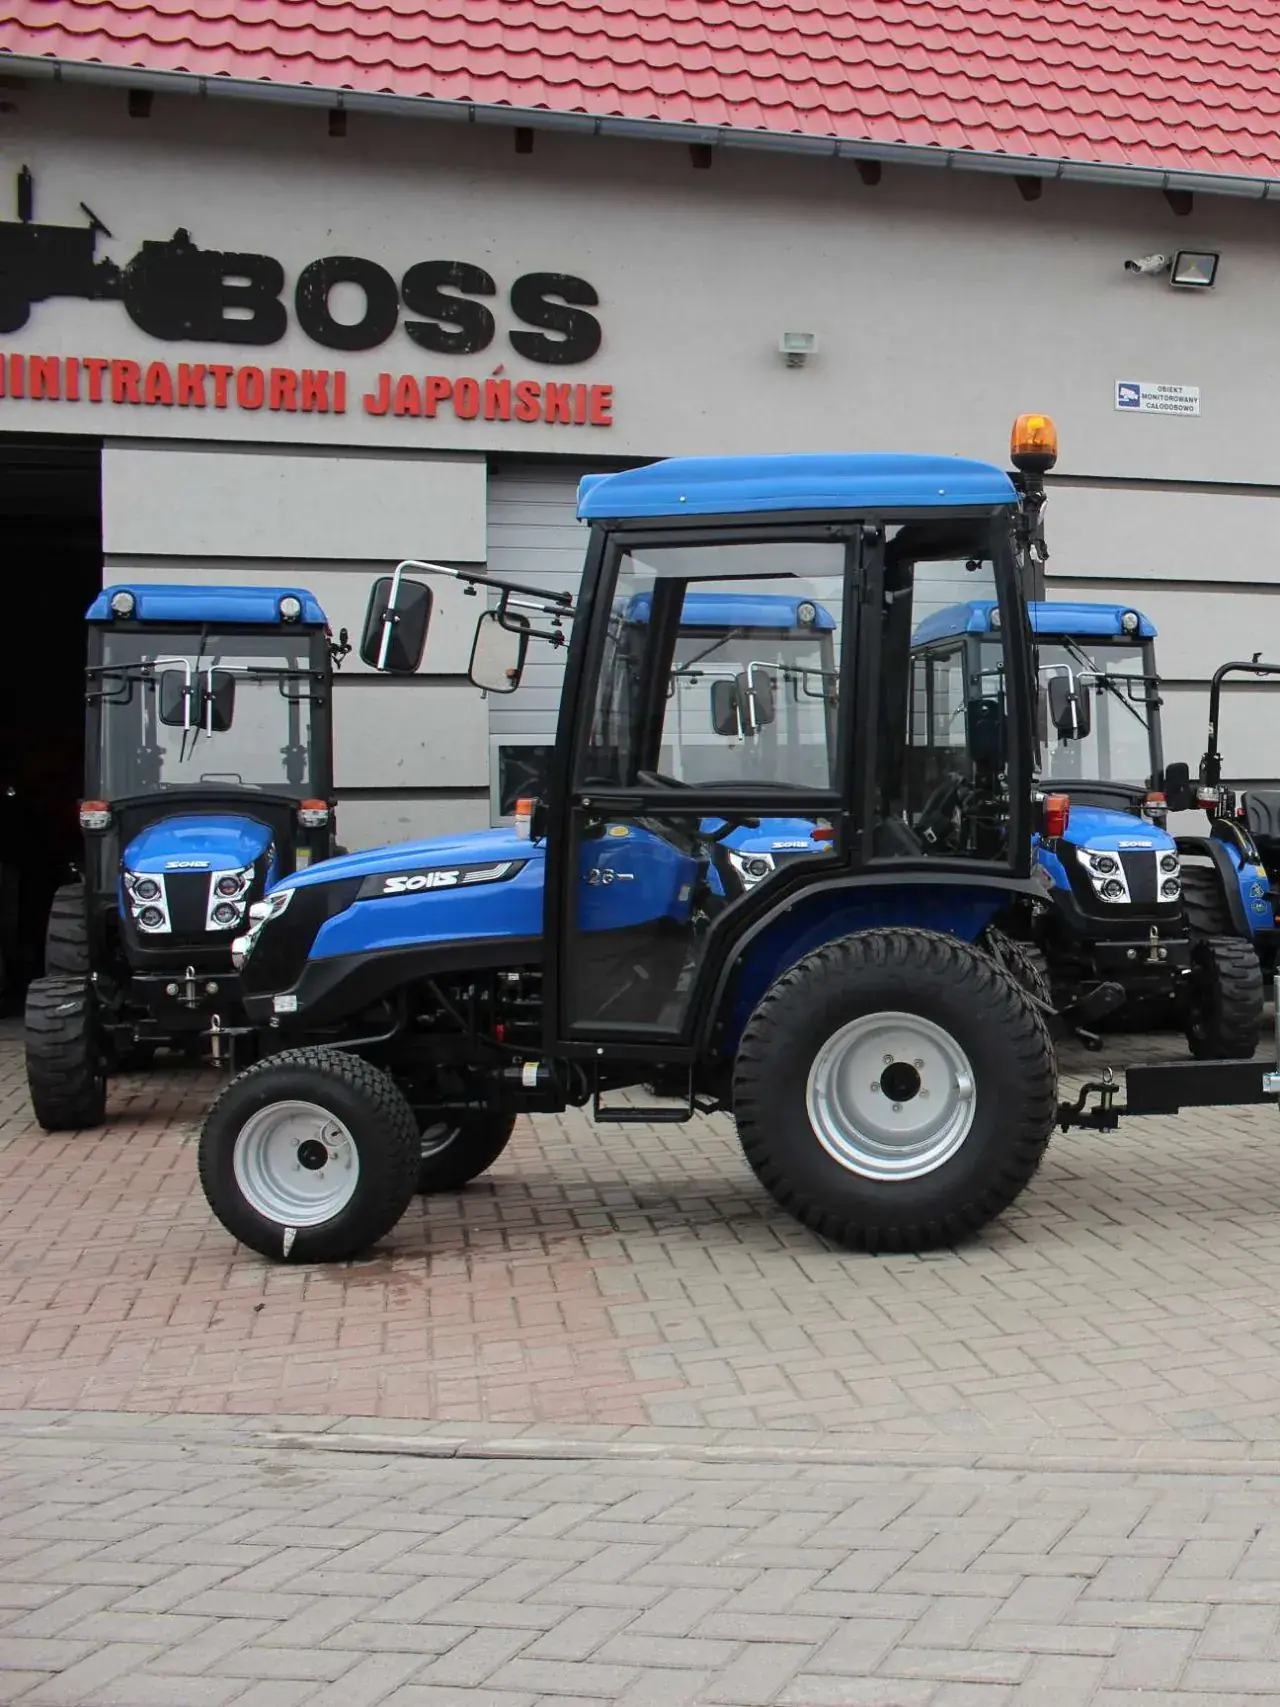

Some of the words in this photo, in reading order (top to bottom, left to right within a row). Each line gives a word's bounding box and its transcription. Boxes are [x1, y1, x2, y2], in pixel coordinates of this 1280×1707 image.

[198, 251, 603, 364] BOSS
[0, 352, 346, 413] INITRAKTORKI
[364, 363, 614, 427] JAPOŃSKIE
[1141, 393, 1198, 404] MONITOROWANY
